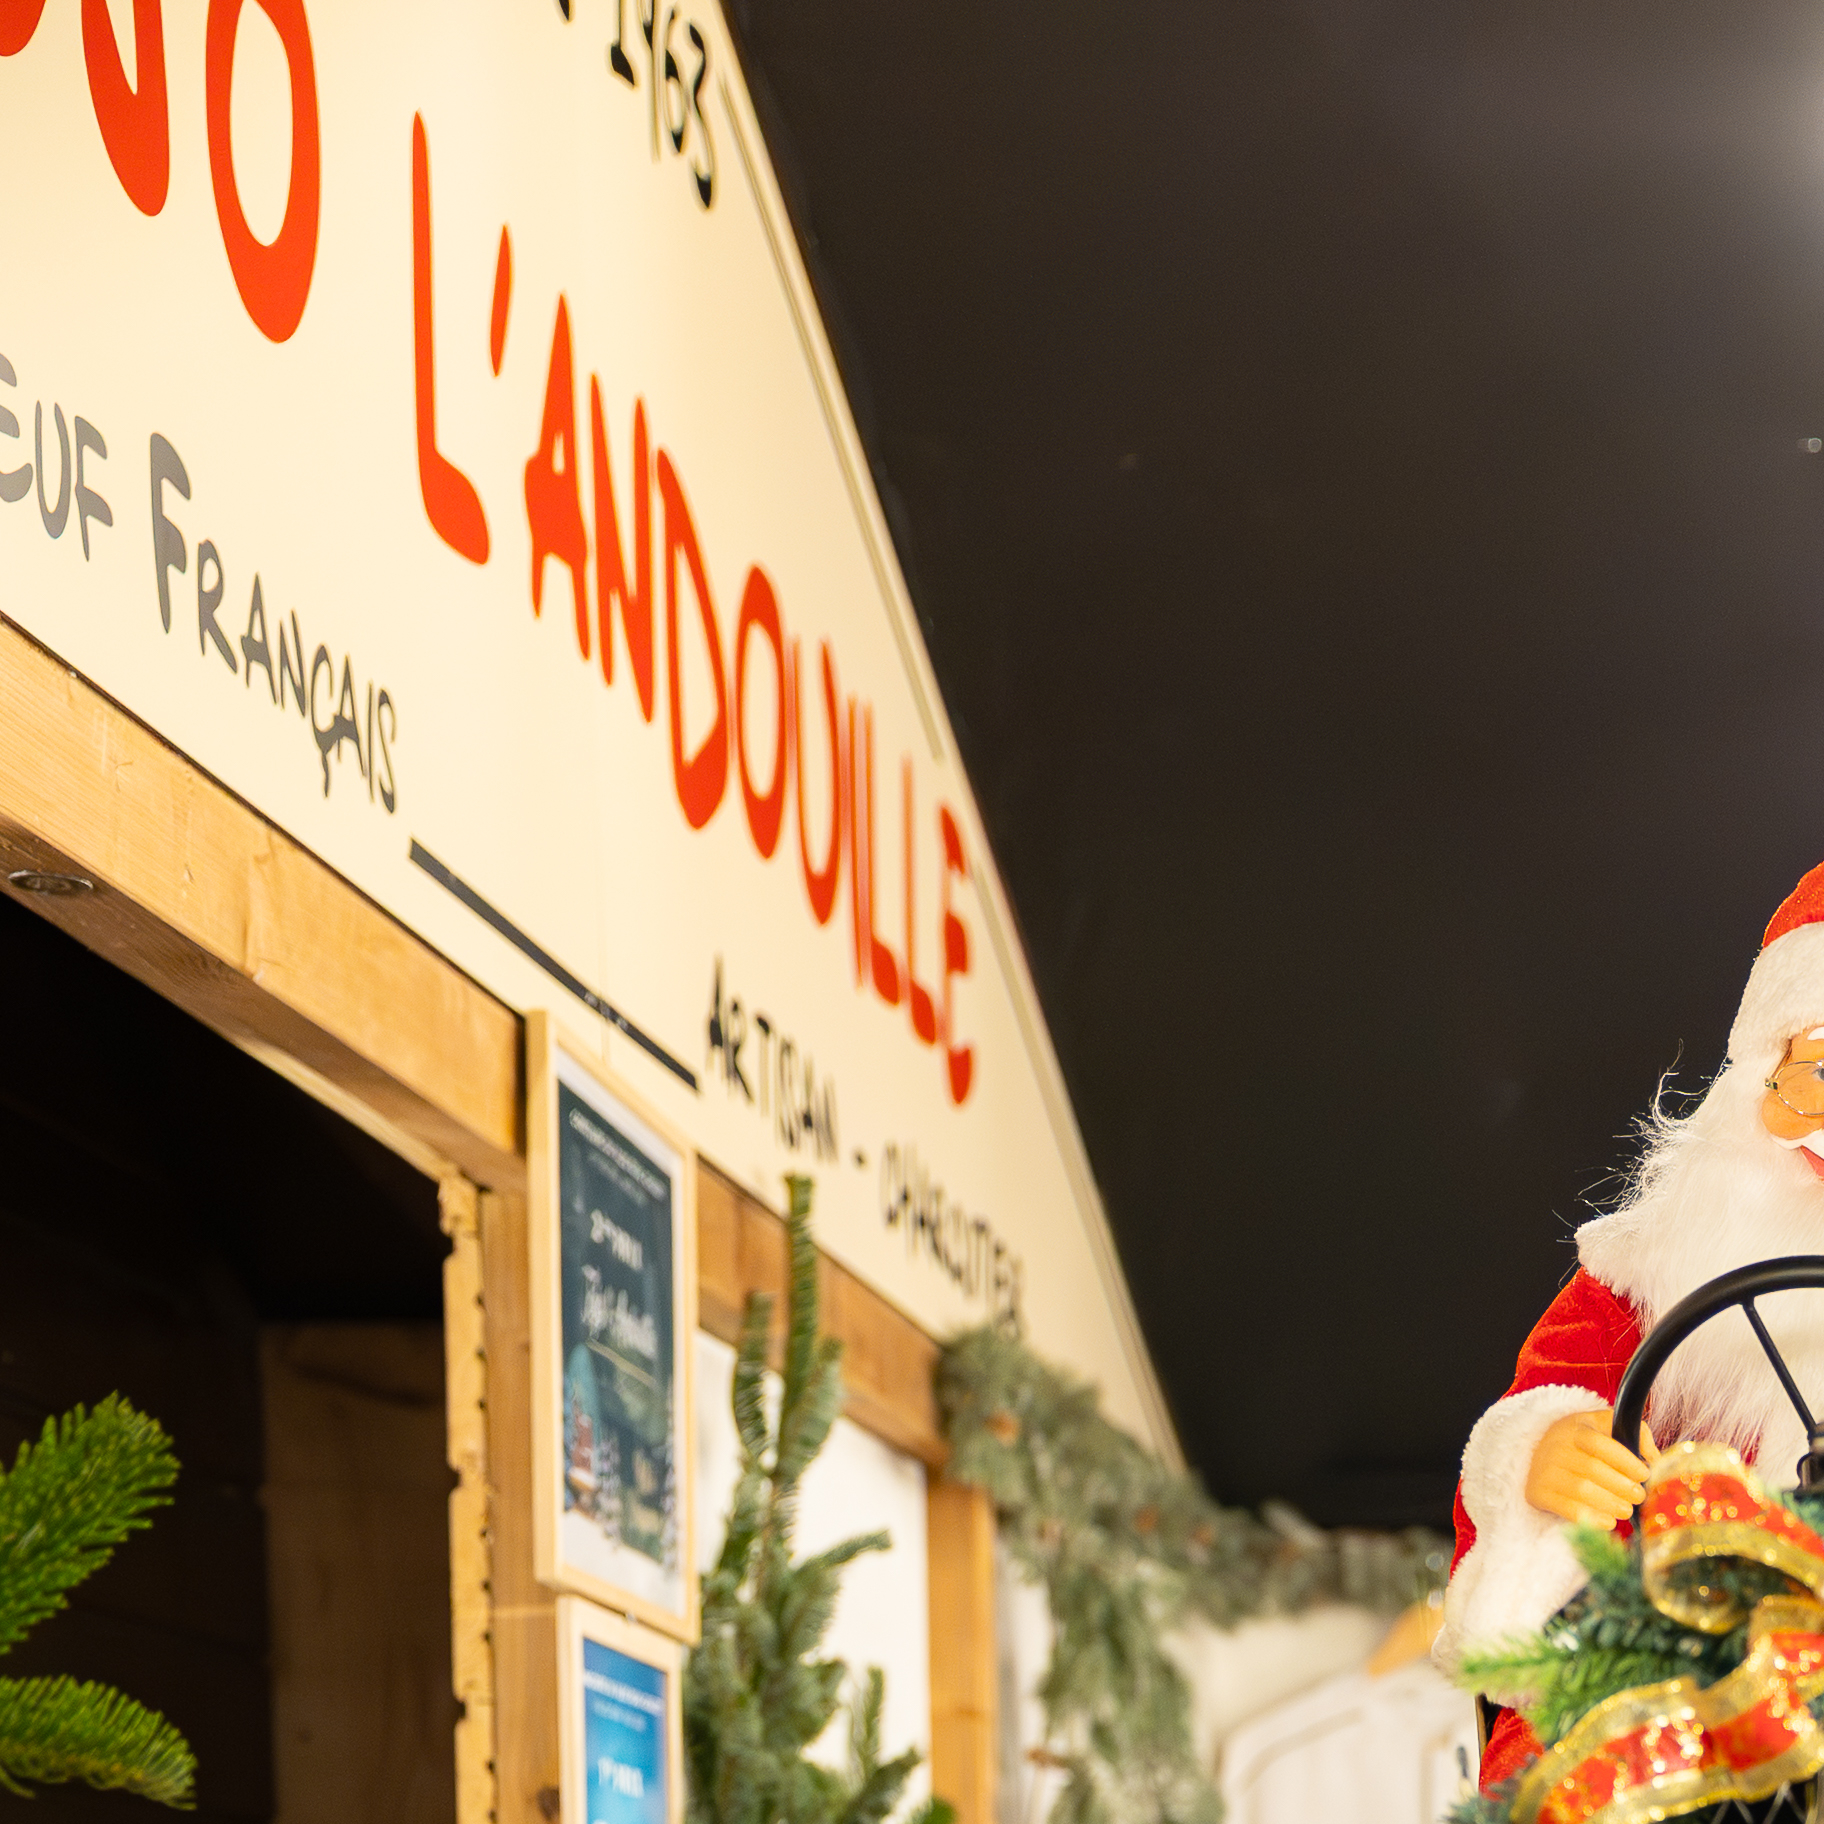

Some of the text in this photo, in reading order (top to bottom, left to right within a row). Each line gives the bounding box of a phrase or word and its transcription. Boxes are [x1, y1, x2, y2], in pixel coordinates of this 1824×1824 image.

[150, 432, 396, 814] FRANÇAIS
[412, 109, 974, 1105] L'ANDOUILLE
[705, 953, 838, 1165] ARTISAN
